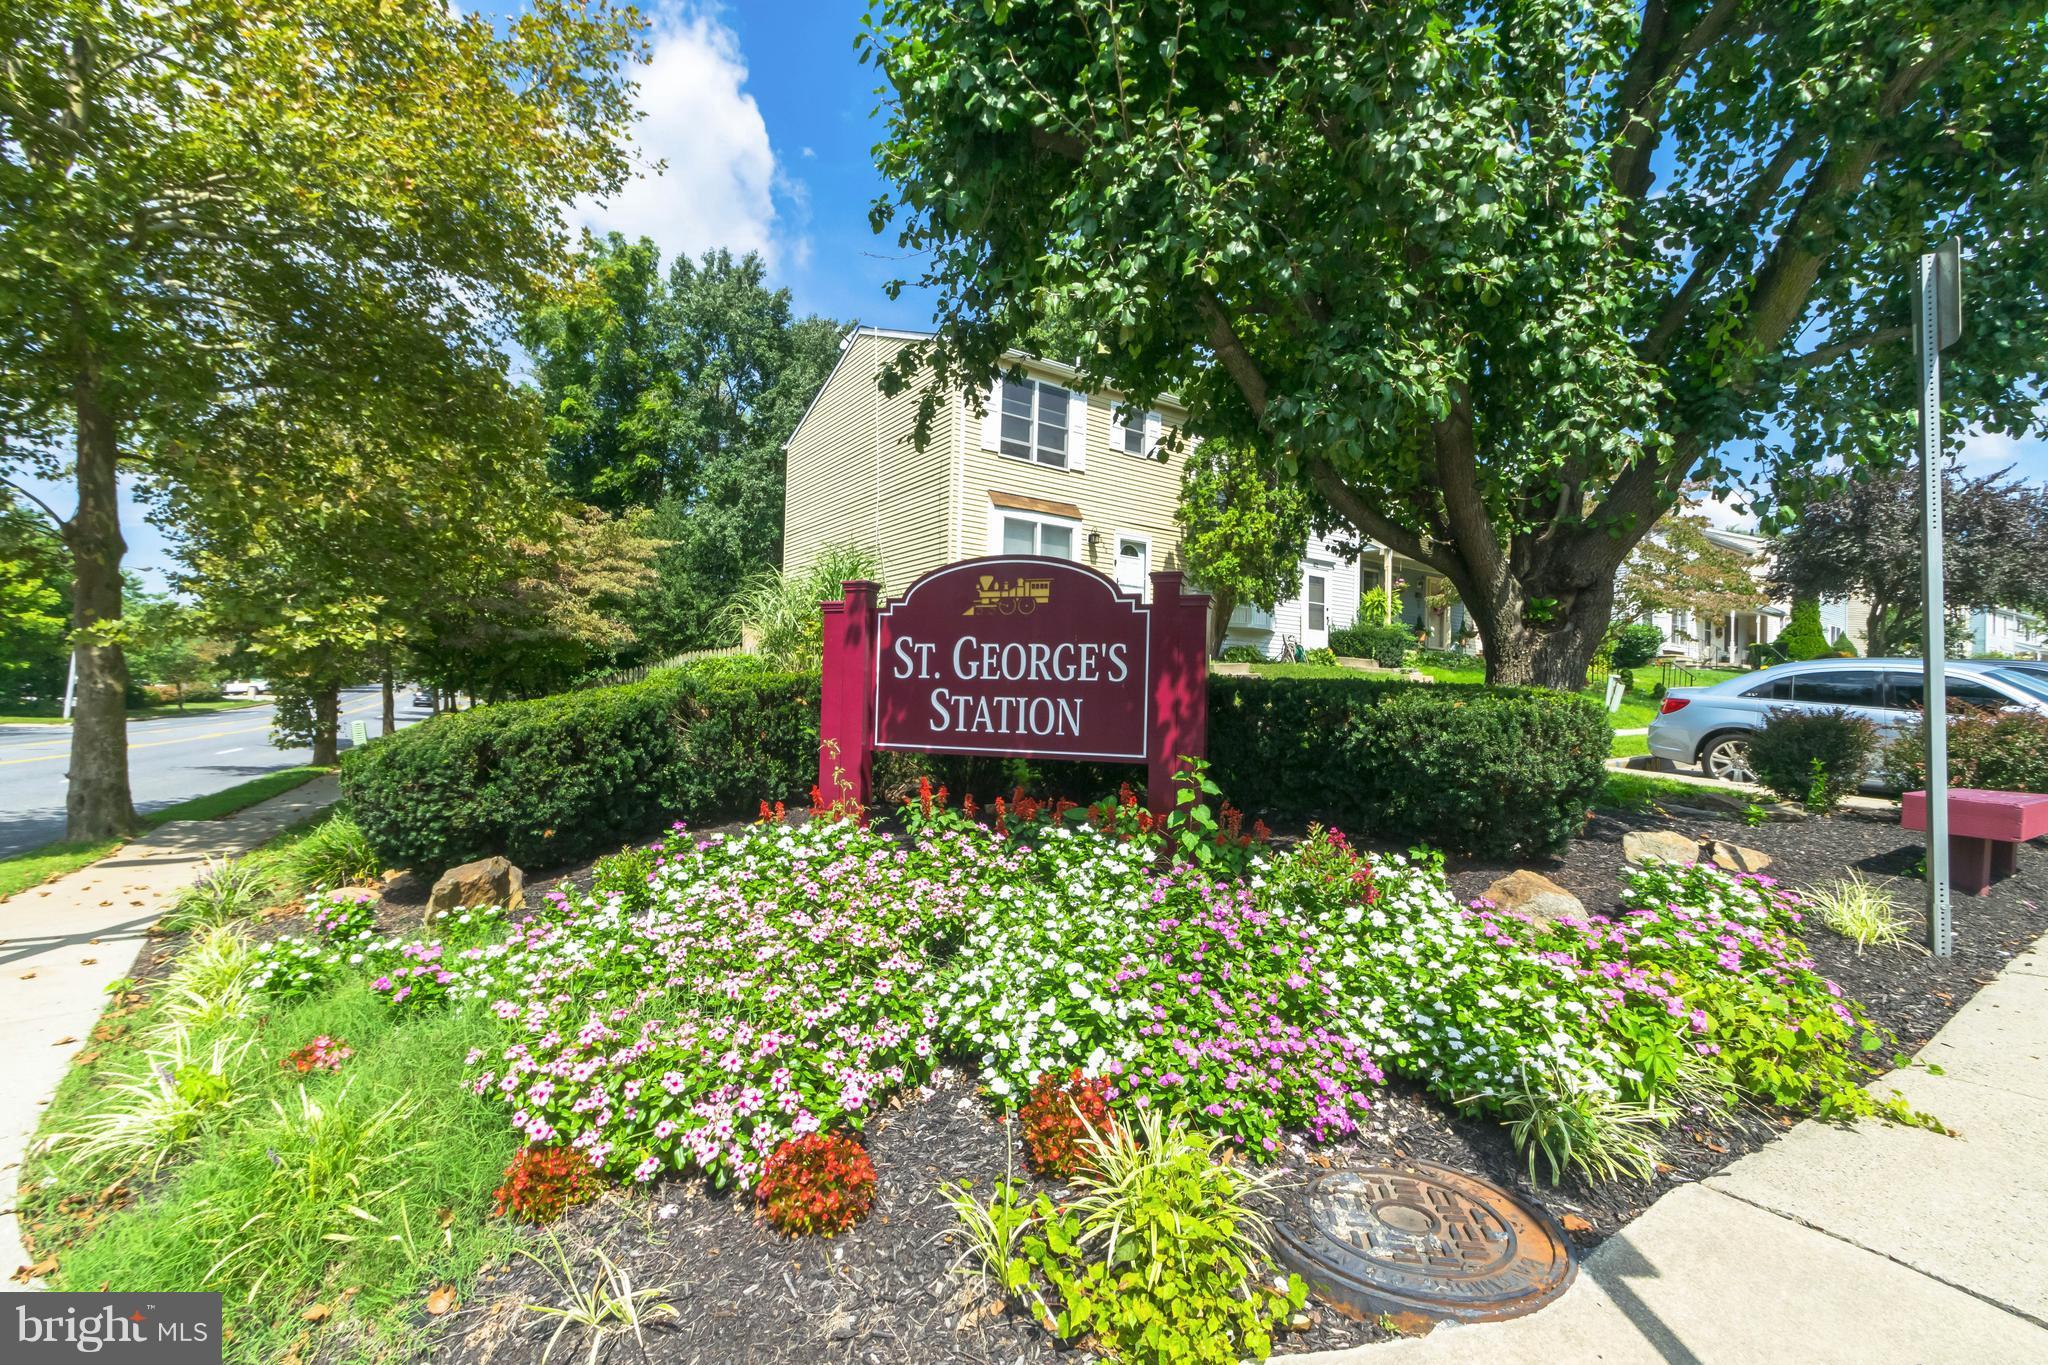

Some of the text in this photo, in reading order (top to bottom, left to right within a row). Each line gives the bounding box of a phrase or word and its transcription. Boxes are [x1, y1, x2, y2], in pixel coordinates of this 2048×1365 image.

[893, 635, 1128, 683] ST. GEORGE'S
[929, 687, 1083, 737] STATION
